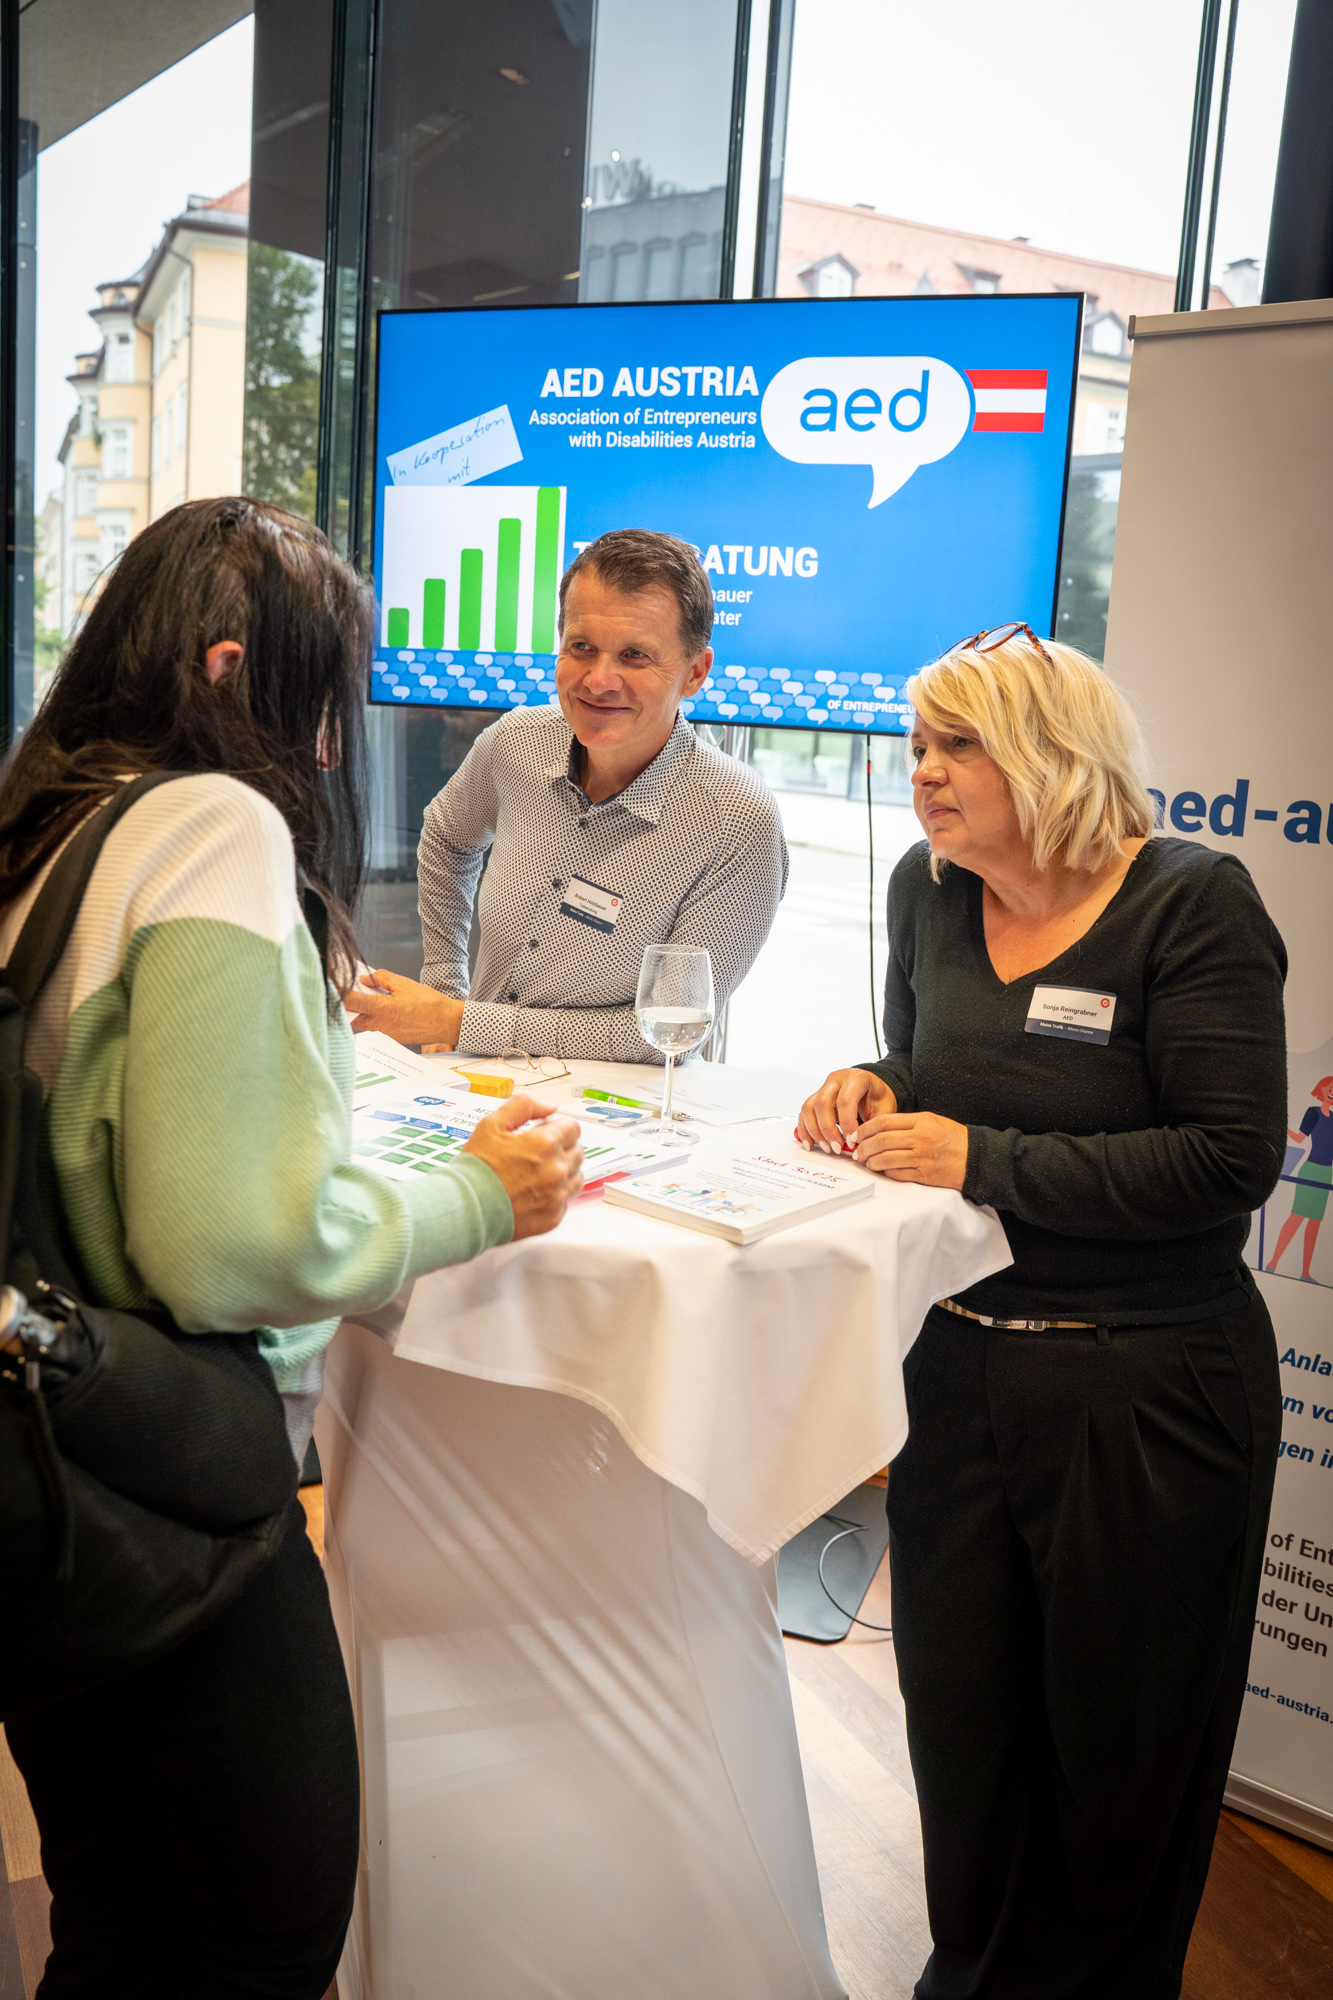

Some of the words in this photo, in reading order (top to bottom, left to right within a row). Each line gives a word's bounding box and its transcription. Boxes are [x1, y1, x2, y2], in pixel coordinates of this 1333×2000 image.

[540, 368, 604, 398] AED
[612, 366, 759, 397] AUSTRIA
[800, 369, 930, 432] aed
[529, 408, 620, 425] Association
[623, 407, 641, 425] of
[643, 408, 757, 428] Entrepreneurs
[568, 431, 602, 448] with
[606, 431, 693, 448] Disabilities
[696, 431, 756, 448] Austria
[392, 465, 407, 480] In
[447, 456, 471, 484] mit
[827, 699, 842, 709] OF
[1146, 779, 1333, 846] ed-a
[1043, 1003, 1060, 1012] Sonja
[1060, 1005, 1097, 1017] Reingrabner
[1279, 1347, 1333, 1377] Anla
[1270, 1533, 1295, 1552] of
[1261, 1590, 1298, 1615] der
